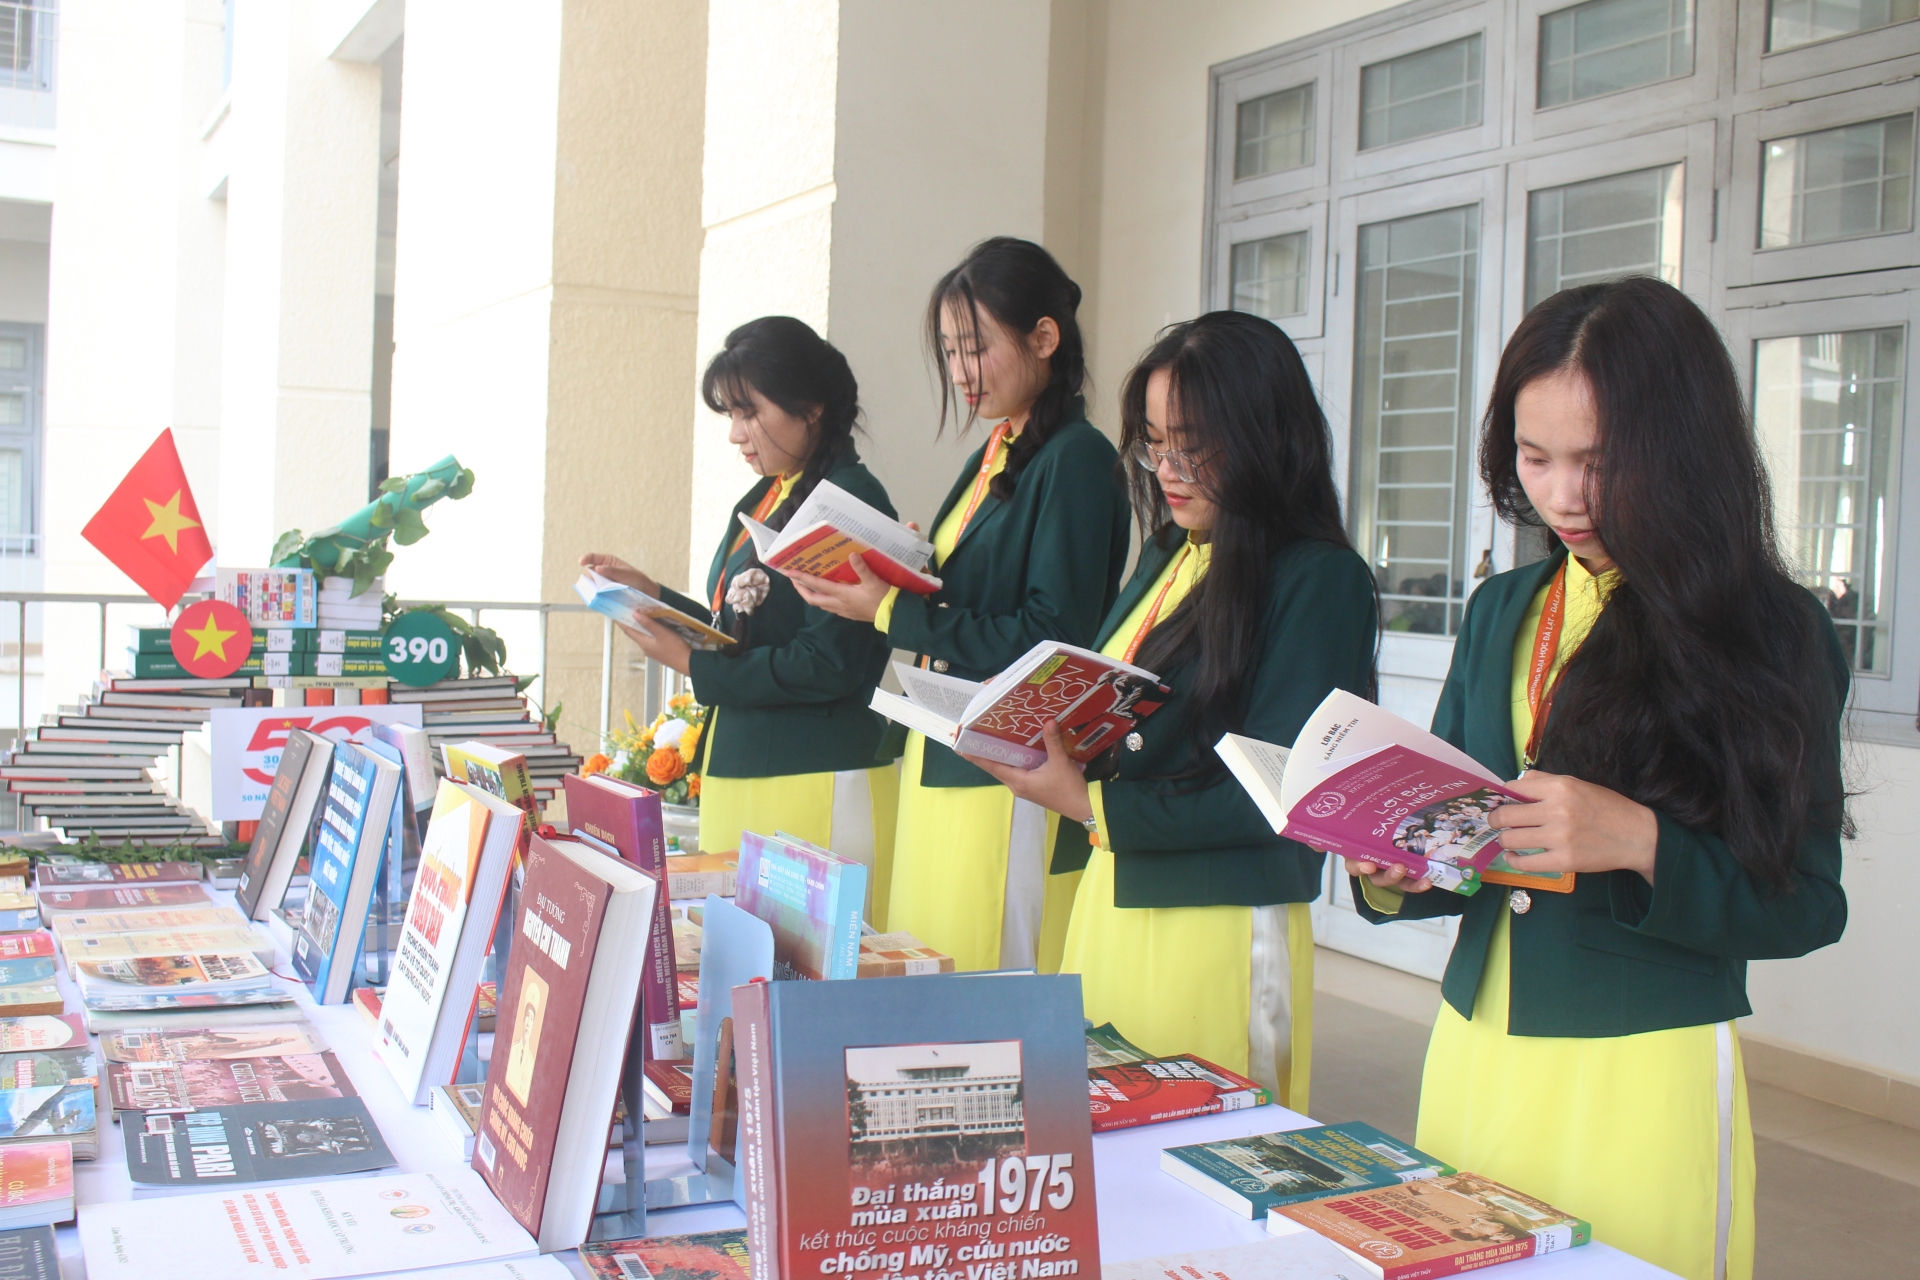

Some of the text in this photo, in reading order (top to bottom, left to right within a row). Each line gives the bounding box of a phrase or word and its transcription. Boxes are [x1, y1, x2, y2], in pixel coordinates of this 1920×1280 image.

[388, 636, 448, 664] 390
[1543, 628, 1551, 641] ĐÀ
[977, 687, 1034, 729] PARIS
[996, 664, 1085, 734] SAIGON
[1013, 677, 1095, 738] HANOI
[1320, 722, 1342, 746] LỜI BÁC
[1322, 717, 1360, 761] SÁNG NIỀM TIN
[263, 755, 279, 764] 30
[241, 794, 252, 802] 50
[1372, 779, 1469, 838] SÁNG NIỀM TIN
[1374, 780, 1433, 816] LỜI BÁC
[600, 831, 616, 846] DỊCH
[536, 891, 567, 925] ĐẠI TƯỚNG
[538, 921, 553, 956] CHÍ
[548, 929, 571, 970] THANH
[652, 935, 663, 958] DỊCH
[660, 933, 668, 953] NAM
[845, 909, 860, 968] MIỀN NAM
[653, 958, 664, 984] CHIẾN
[661, 954, 671, 977] MIỀN
[748, 1022, 757, 1050] Nam
[750, 1052, 759, 1076] Việt
[751, 1076, 761, 1097] tộc
[745, 1086, 754, 1136] 1975
[753, 1098, 761, 1121] dân
[190, 1144, 237, 1178] PARI
[749, 1143, 758, 1194] xuân
[851, 1152, 1074, 1216] Đại thắng 1975
[851, 1202, 978, 1227] mùa xuân
[1323, 1200, 1400, 1232] THẮNG
[1383, 1225, 1438, 1250] ĐẠI
[1348, 1195, 1386, 1213] 1975
[1380, 1207, 1423, 1230] XUÂN
[799, 1214, 1046, 1251] kết thúc cuộc kháng chiến
[819, 1234, 1071, 1275] chống Mỹ, cứu nước
[966, 1259, 1020, 1280] Việt
[1022, 1257, 1079, 1278] Nam
[1454, 1241, 1529, 1267] ĐẠI THẮNG MÙA XUÂN 1975
